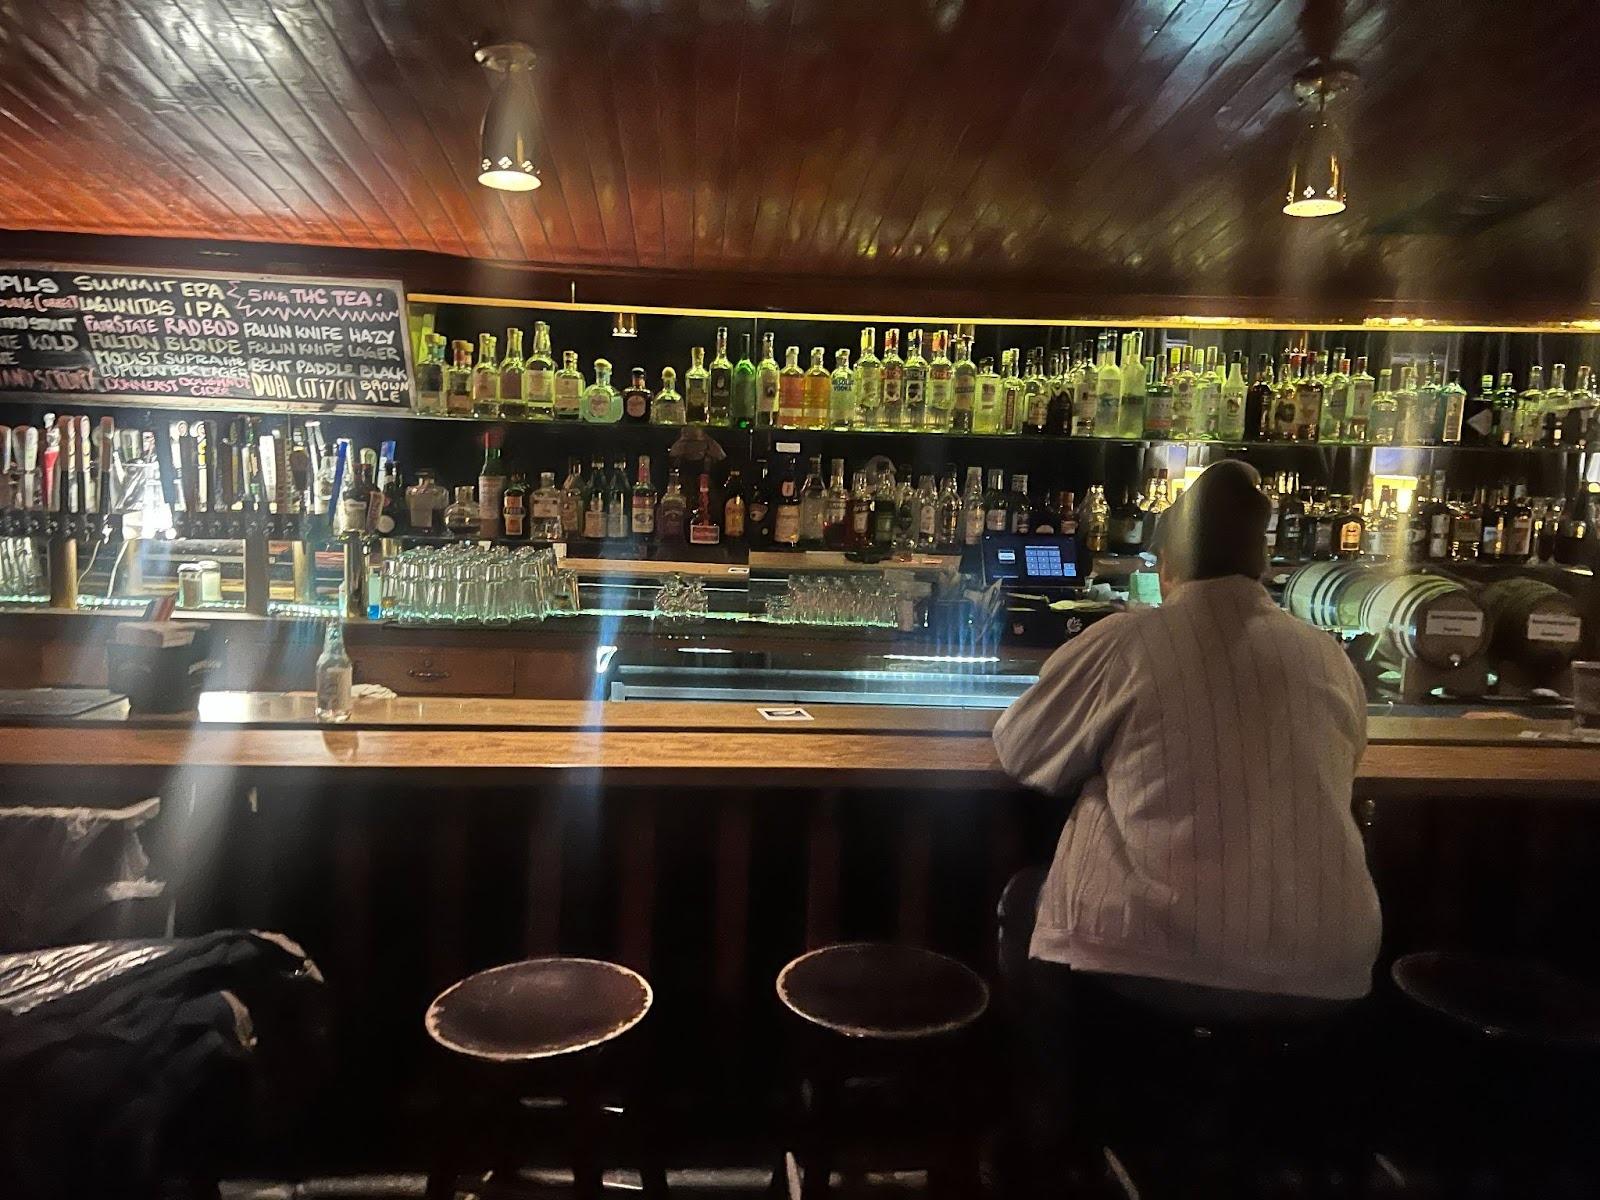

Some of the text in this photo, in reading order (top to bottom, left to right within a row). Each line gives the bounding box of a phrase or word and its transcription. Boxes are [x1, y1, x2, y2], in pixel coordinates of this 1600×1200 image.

[73, 275, 225, 300] SUMMIT EPA
[290, 288, 329, 305] THC
[184, 301, 231, 318] IPA
[89, 333, 243, 355] FULTON BLONDE
[294, 325, 343, 341] KNIFE
[348, 327, 395, 345] HAZY
[162, 352, 223, 366] SUPRA
[247, 340, 401, 361] FALLIN KNIFE LAGER
[248, 357, 408, 381] BENT PADDLE BLACK
[250, 371, 297, 400] DUAL
[360, 378, 409, 392] BROWN
[364, 390, 401, 403] ALE
